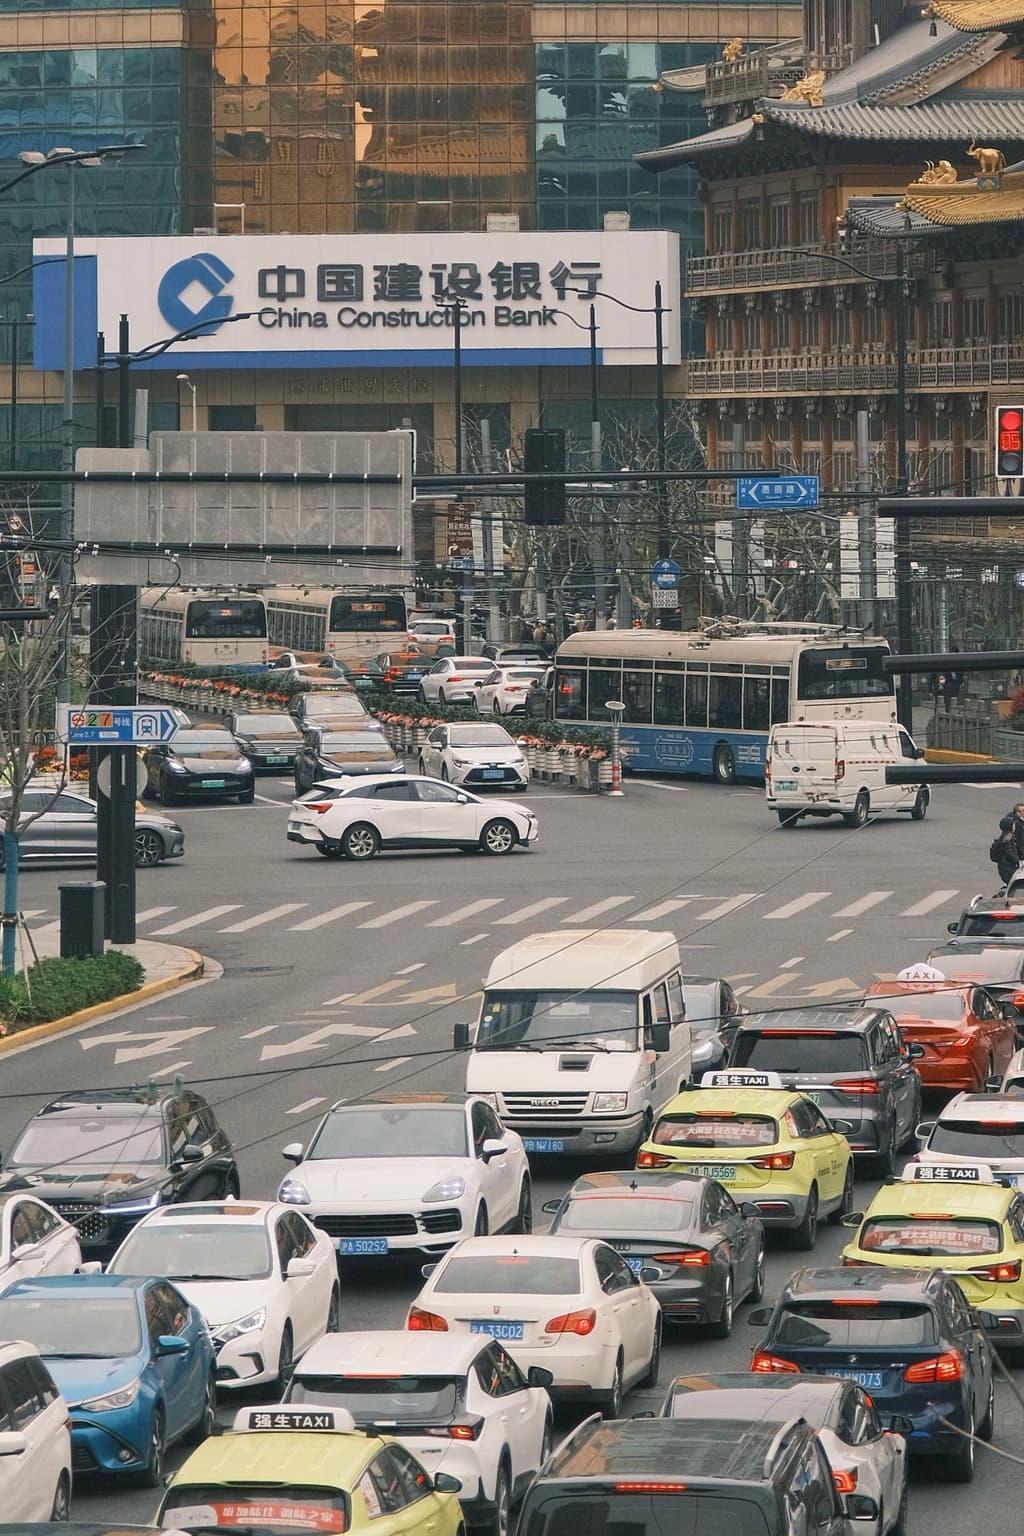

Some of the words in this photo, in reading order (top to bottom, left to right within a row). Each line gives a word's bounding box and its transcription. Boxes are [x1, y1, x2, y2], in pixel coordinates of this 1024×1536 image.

[257, 261, 602, 302] 中国建设银行
[258, 307, 328, 328] China
[337, 307, 485, 327] Construction
[494, 305, 558, 327] Bank
[530, 1099, 560, 1107] IVECO
